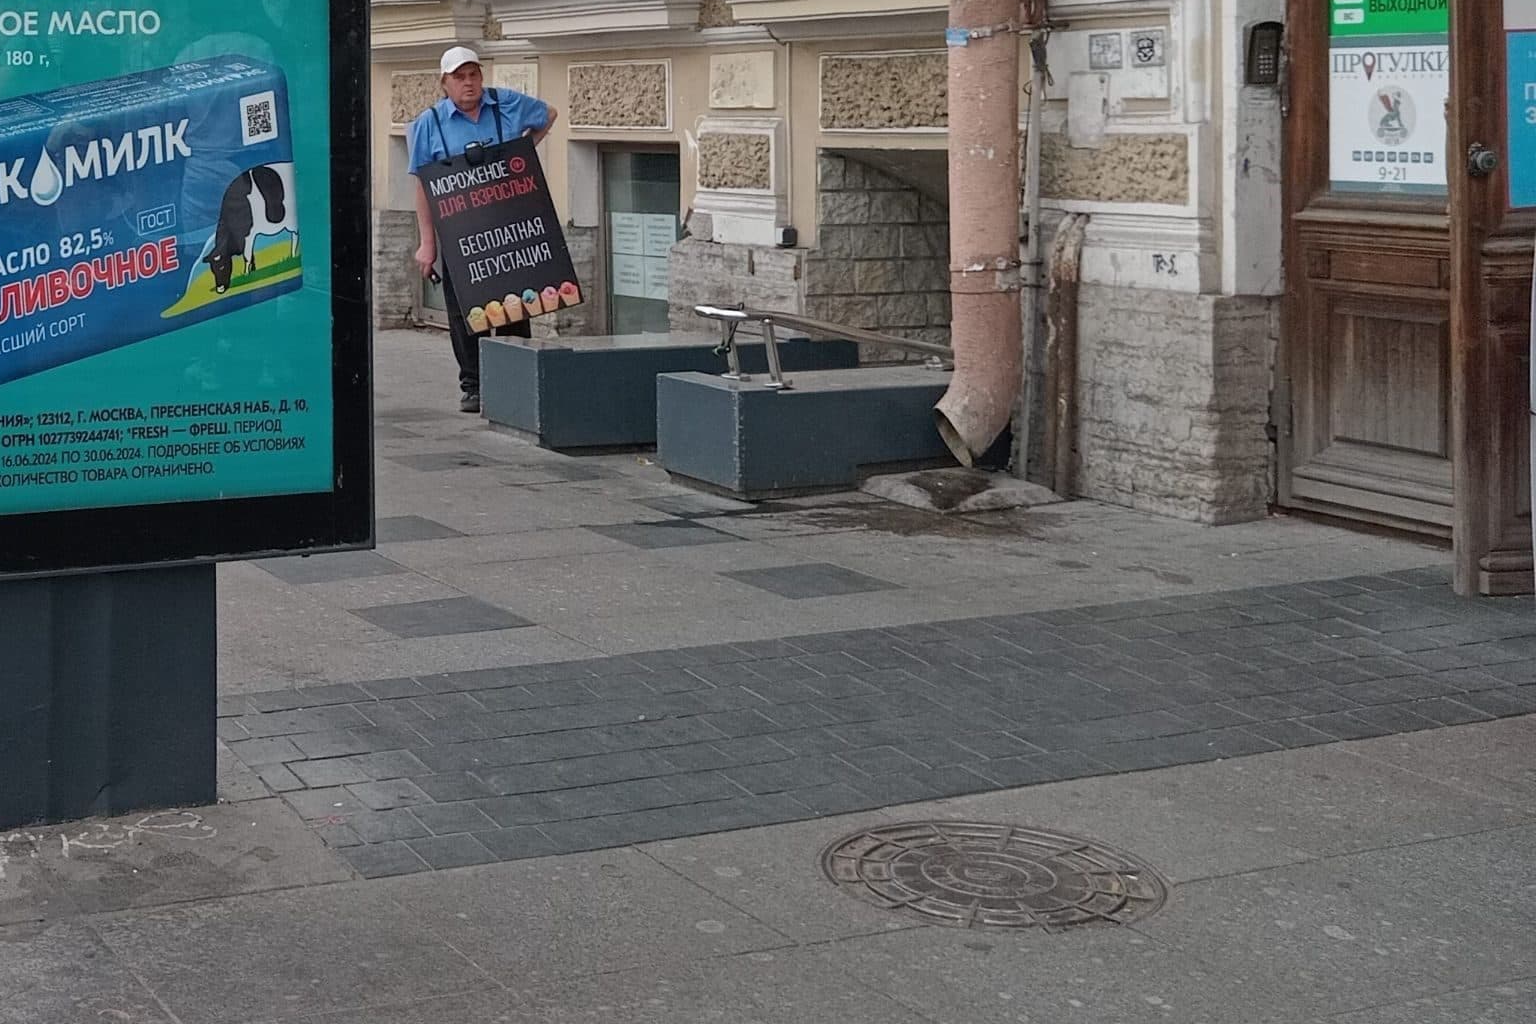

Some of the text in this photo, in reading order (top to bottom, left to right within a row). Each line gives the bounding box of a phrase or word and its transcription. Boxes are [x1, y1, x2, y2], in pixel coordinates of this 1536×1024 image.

[48, 9, 161, 36] МАСЛО
[6, 51, 34, 66] 180
[429, 160, 509, 197] МОРОЖЕНОЕ
[438, 176, 539, 219] ДЛЯ ВЗРОСЛЫХ
[140, 207, 172, 231] ГОСТ
[60, 228, 114, 258] 82,5%
[458, 216, 545, 257] БЕСПЛАТНАЯ
[468, 242, 552, 285] ДЕГУСТАЦИЯ
[50, 313, 87, 339] СОРТ
[89, 407, 147, 423] МОСКВА,
[151, 401, 240, 419] ПРЕСНЕНСКАЯ
[2, 434, 34, 448] ОГРН
[190, 423, 231, 436] ФРЕШ.
[234, 419, 282, 434] ПЕРИОД
[2, 453, 57, 467] 16.06.2024
[62, 451, 80, 464] ПО
[148, 444, 220, 459] ПОДРОБНЕЕ
[224, 442, 240, 454] ОБ
[243, 437, 305, 452] УСЛОВИЯХ
[82, 468, 128, 482] ТОВАРА
[132, 462, 214, 478] ОГРАНИЧЕНО.
